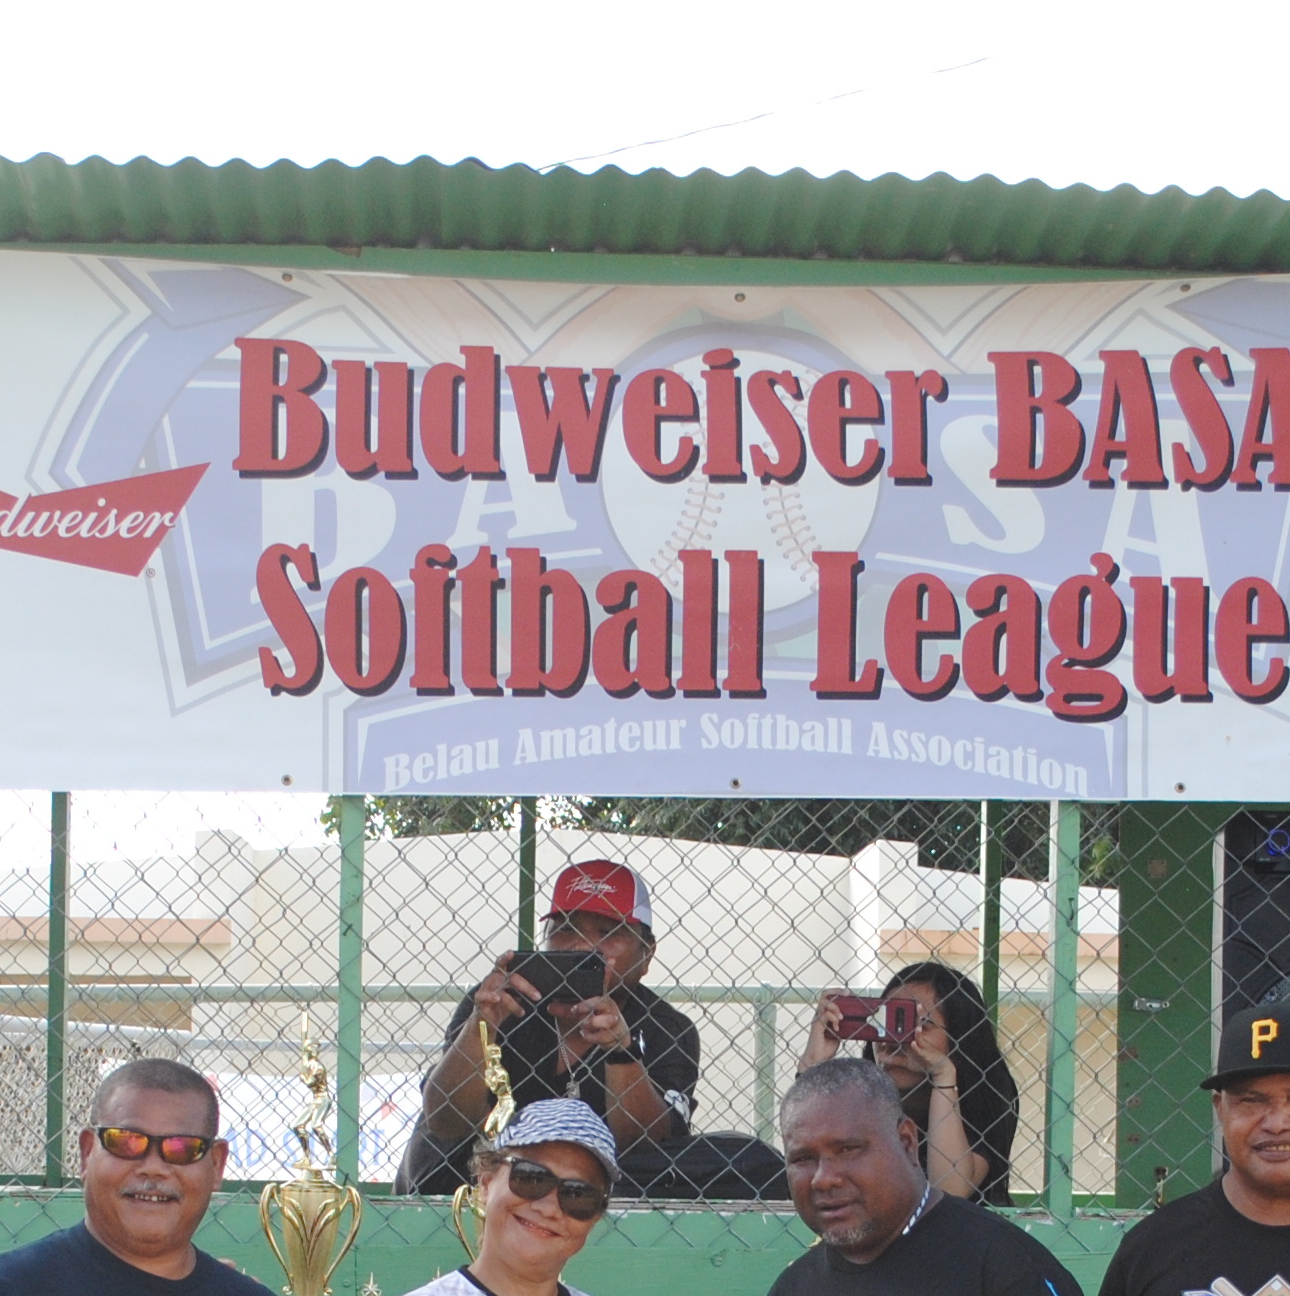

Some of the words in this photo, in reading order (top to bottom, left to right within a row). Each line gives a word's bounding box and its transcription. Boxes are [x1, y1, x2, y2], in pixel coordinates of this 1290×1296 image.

[232, 337, 949, 486] Budweiser
[256, 543, 767, 700] Softball
[809, 551, 1290, 724] League
[383, 738, 500, 793] Belau
[513, 717, 686, 765] Amateur
[701, 712, 853, 755] Softball
[866, 721, 1089, 797] Association
[1250, 1018, 1279, 1060] P
